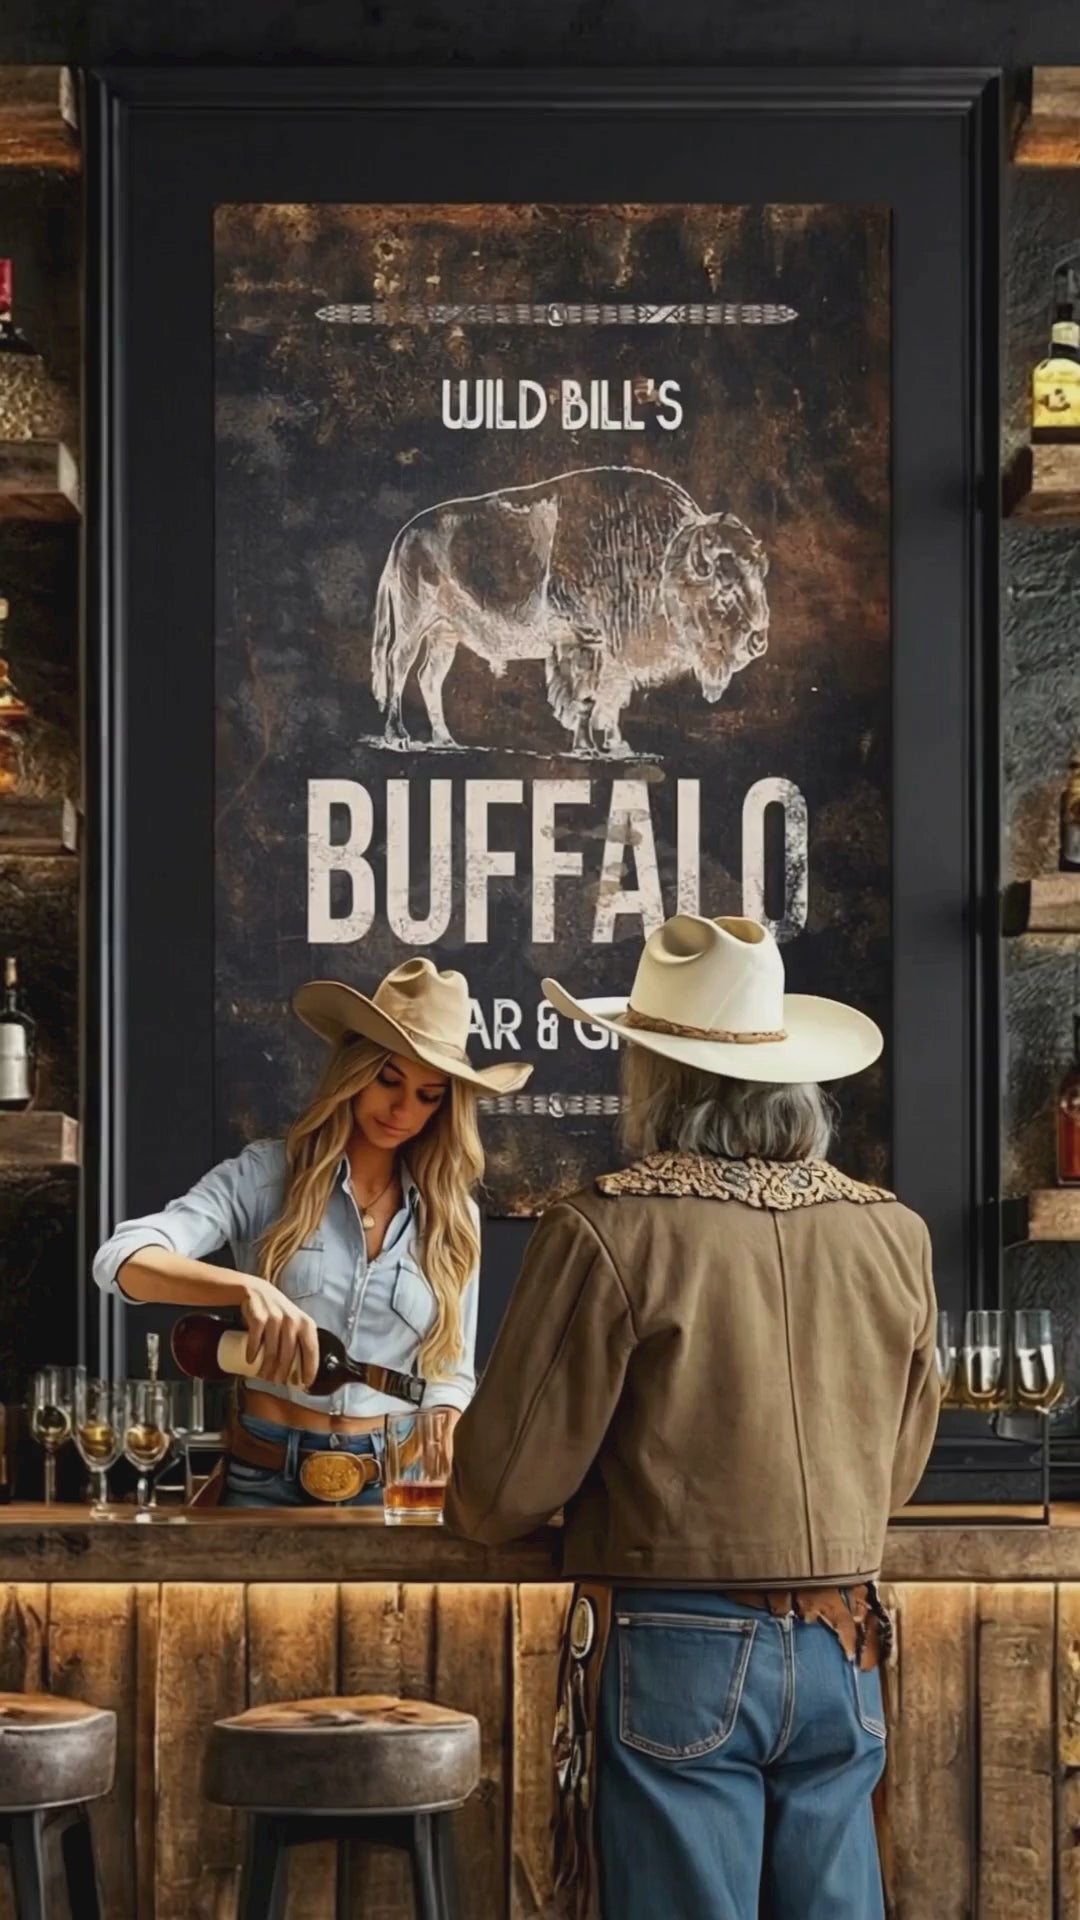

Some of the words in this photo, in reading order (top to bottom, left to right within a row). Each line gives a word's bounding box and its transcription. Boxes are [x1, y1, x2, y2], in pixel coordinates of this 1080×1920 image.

[442, 379, 548, 430] WILD
[561, 379, 683, 431] BILL'S
[307, 777, 809, 945] BUFFALO
[467, 997, 522, 1050] AR
[537, 999, 559, 1050] &
